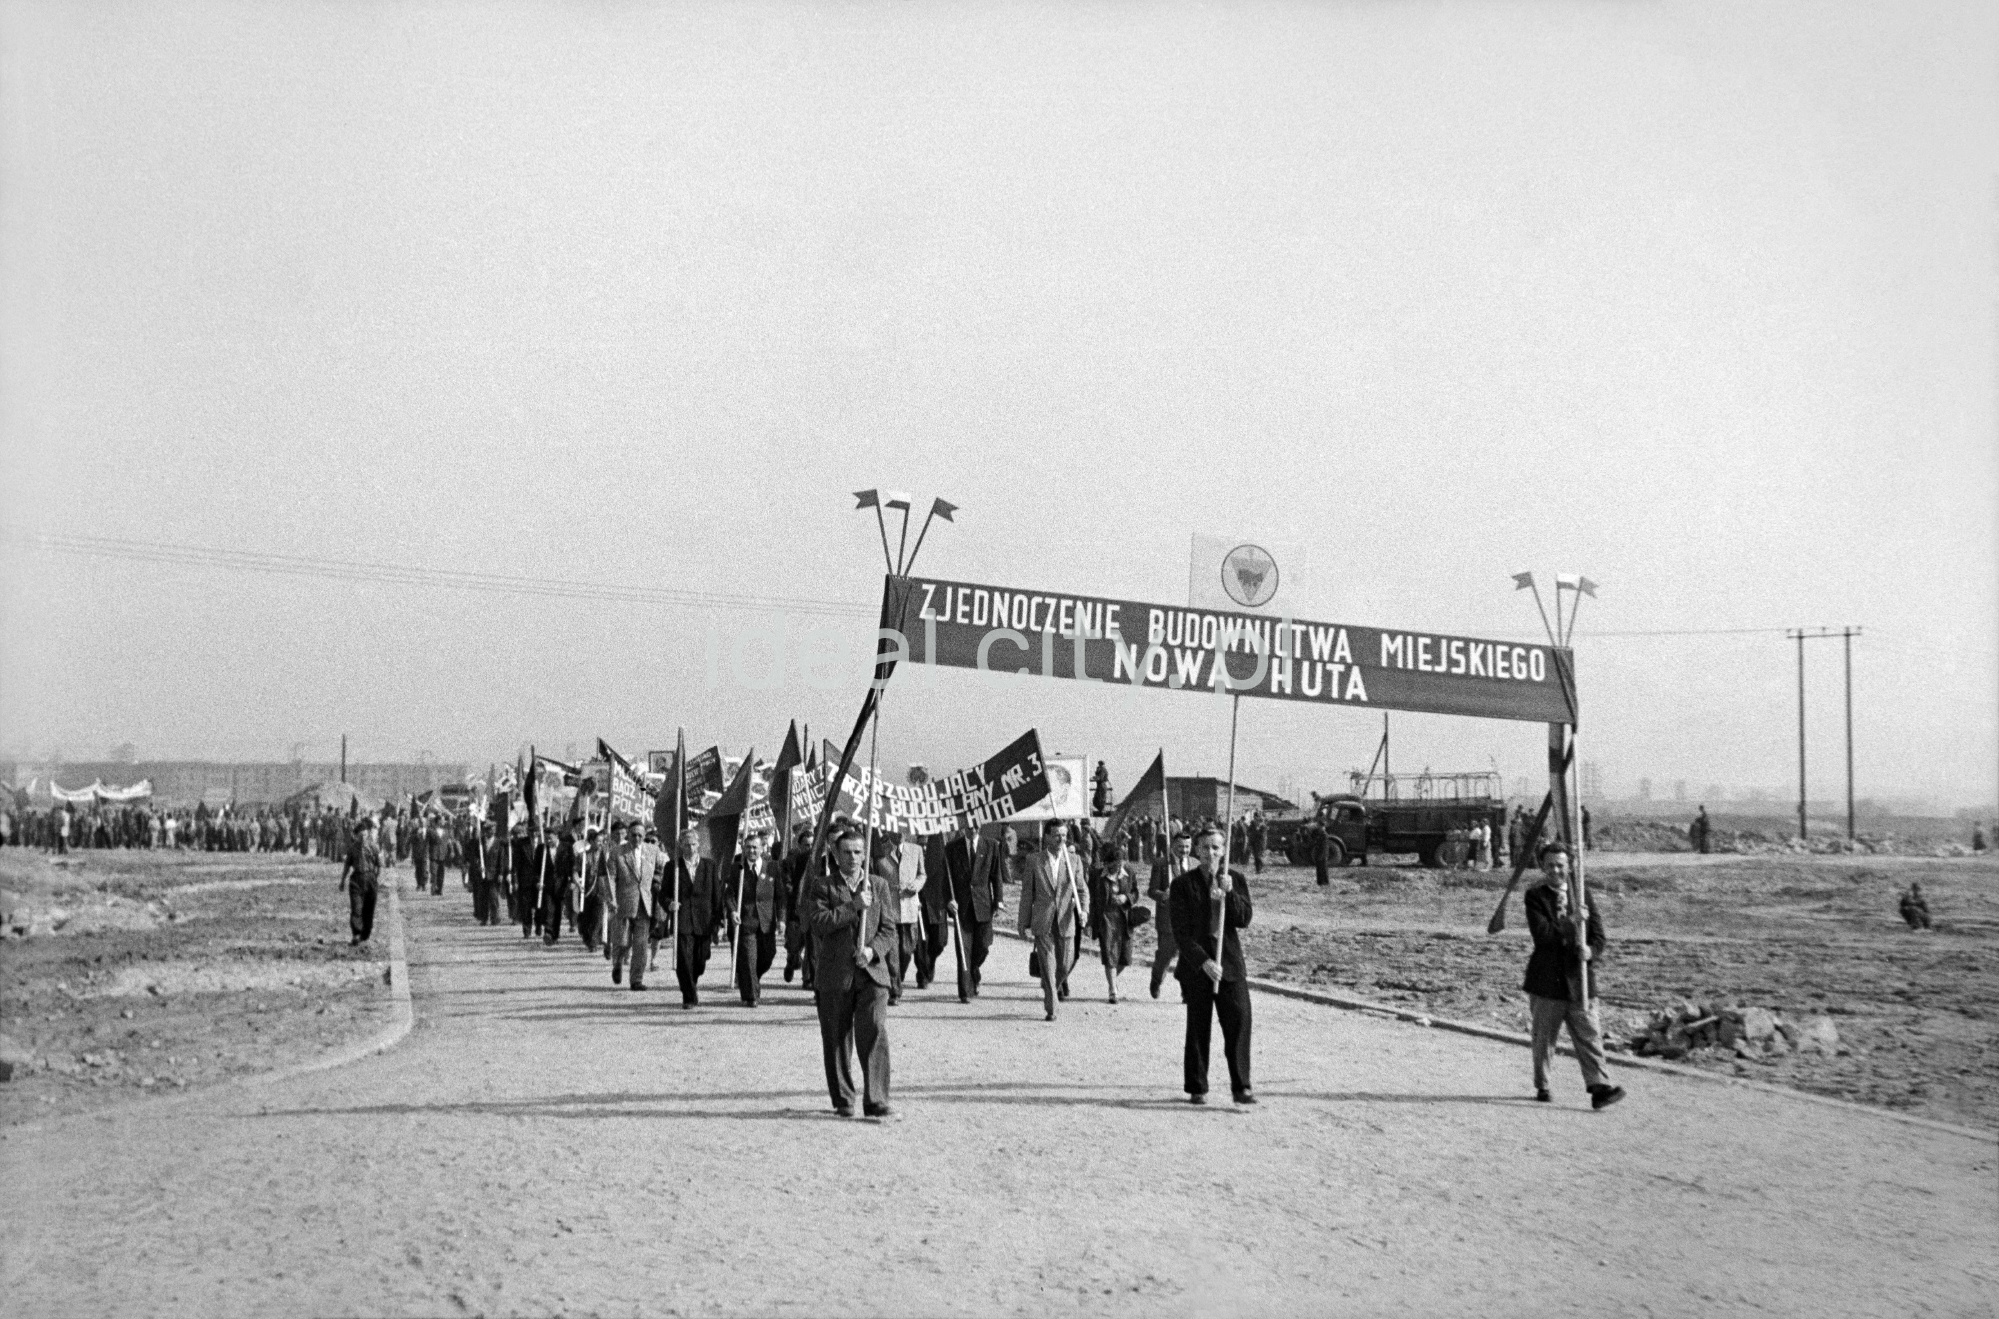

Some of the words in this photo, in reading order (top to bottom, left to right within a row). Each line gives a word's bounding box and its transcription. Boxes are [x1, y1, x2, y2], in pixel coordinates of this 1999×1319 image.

[919, 584, 1120, 640] ZJEDNOCZENIE
[1148, 608, 1353, 663] BUDOWNICTWA
[1380, 633, 1546, 682] MIEJSKIEGO
[1113, 641, 1234, 689] NOWA
[1271, 657, 1368, 702] HUTA
[890, 780, 994, 818] BUDOWLANY
[1027, 751, 1043, 777] 3
[966, 793, 1016, 829] HUTA
